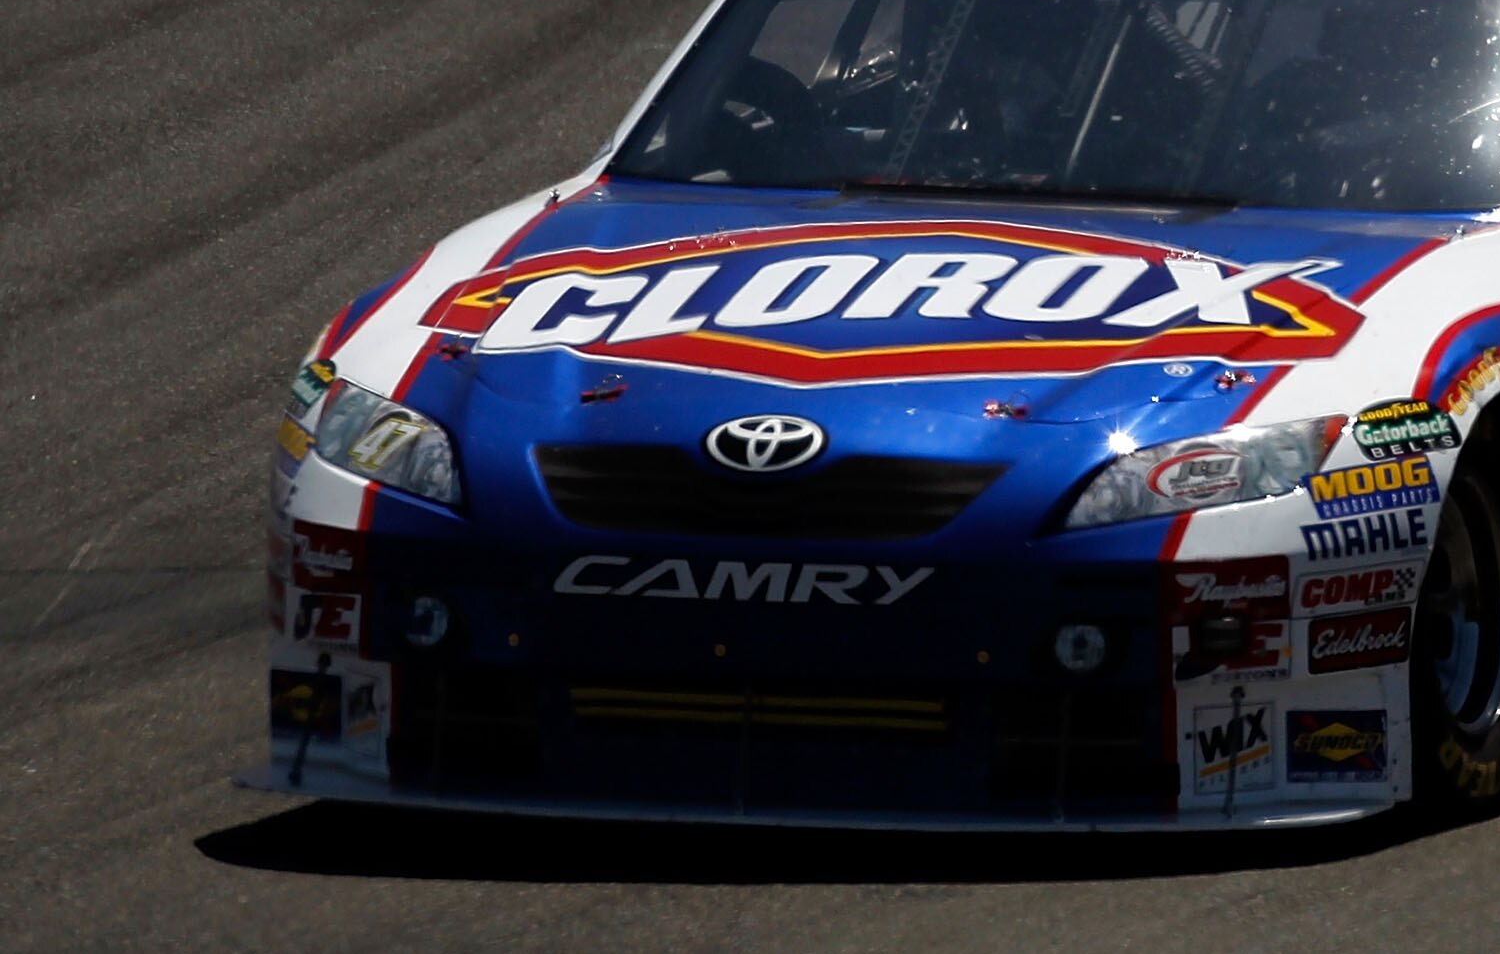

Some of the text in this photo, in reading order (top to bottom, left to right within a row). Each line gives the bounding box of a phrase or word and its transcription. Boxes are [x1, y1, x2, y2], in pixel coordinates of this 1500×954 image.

[480, 252, 1335, 349] CLOROX
[1355, 413, 1452, 446] Gatorback
[1359, 401, 1430, 422] GOODYEAR
[348, 417, 428, 470] 47
[1370, 435, 1456, 458] BELTS
[1309, 456, 1431, 503] MOOG
[1323, 487, 1436, 518] CHASSIS PARTS
[1300, 508, 1428, 562] MAHLE
[553, 555, 935, 605] CAMRY
[1301, 569, 1394, 608] COMP
[1312, 620, 1408, 660] Edelbrock
